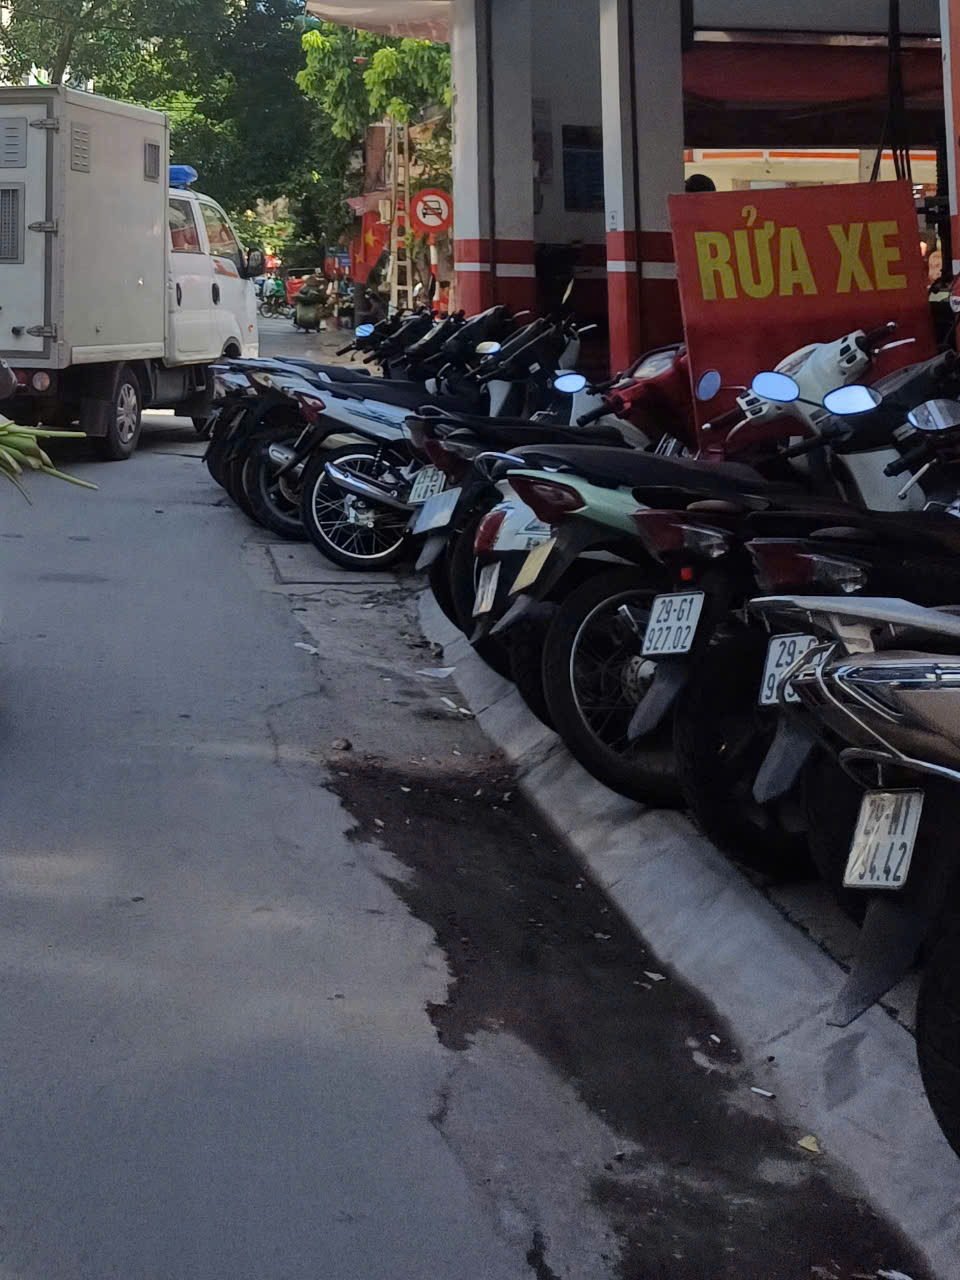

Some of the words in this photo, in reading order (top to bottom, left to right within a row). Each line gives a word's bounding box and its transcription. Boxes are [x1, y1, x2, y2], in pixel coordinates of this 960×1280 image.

[694, 205, 818, 301] RỬA
[827, 220, 907, 293] XE
[656, 597, 695, 624] 29-G1
[645, 625, 692, 651] 927.02
